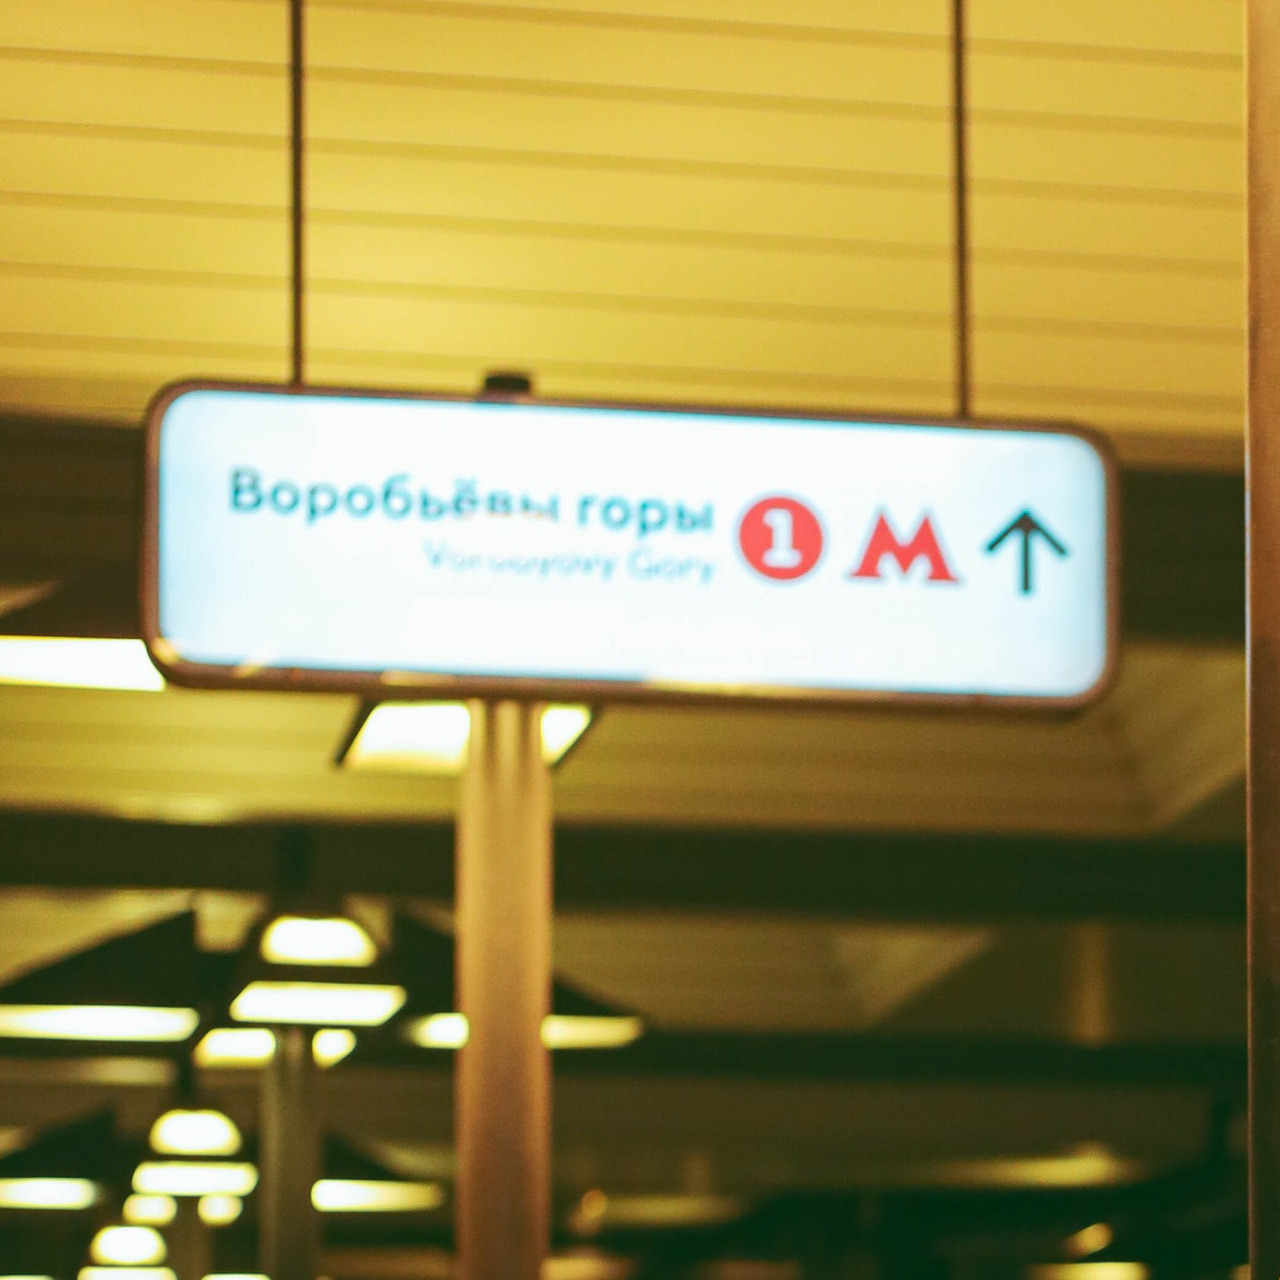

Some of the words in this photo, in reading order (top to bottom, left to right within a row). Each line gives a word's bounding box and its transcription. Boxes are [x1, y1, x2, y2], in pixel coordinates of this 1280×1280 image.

[231, 466, 559, 526] Воробьёвы
[575, 494, 714, 538] горы
[626, 546, 716, 585] Gory
